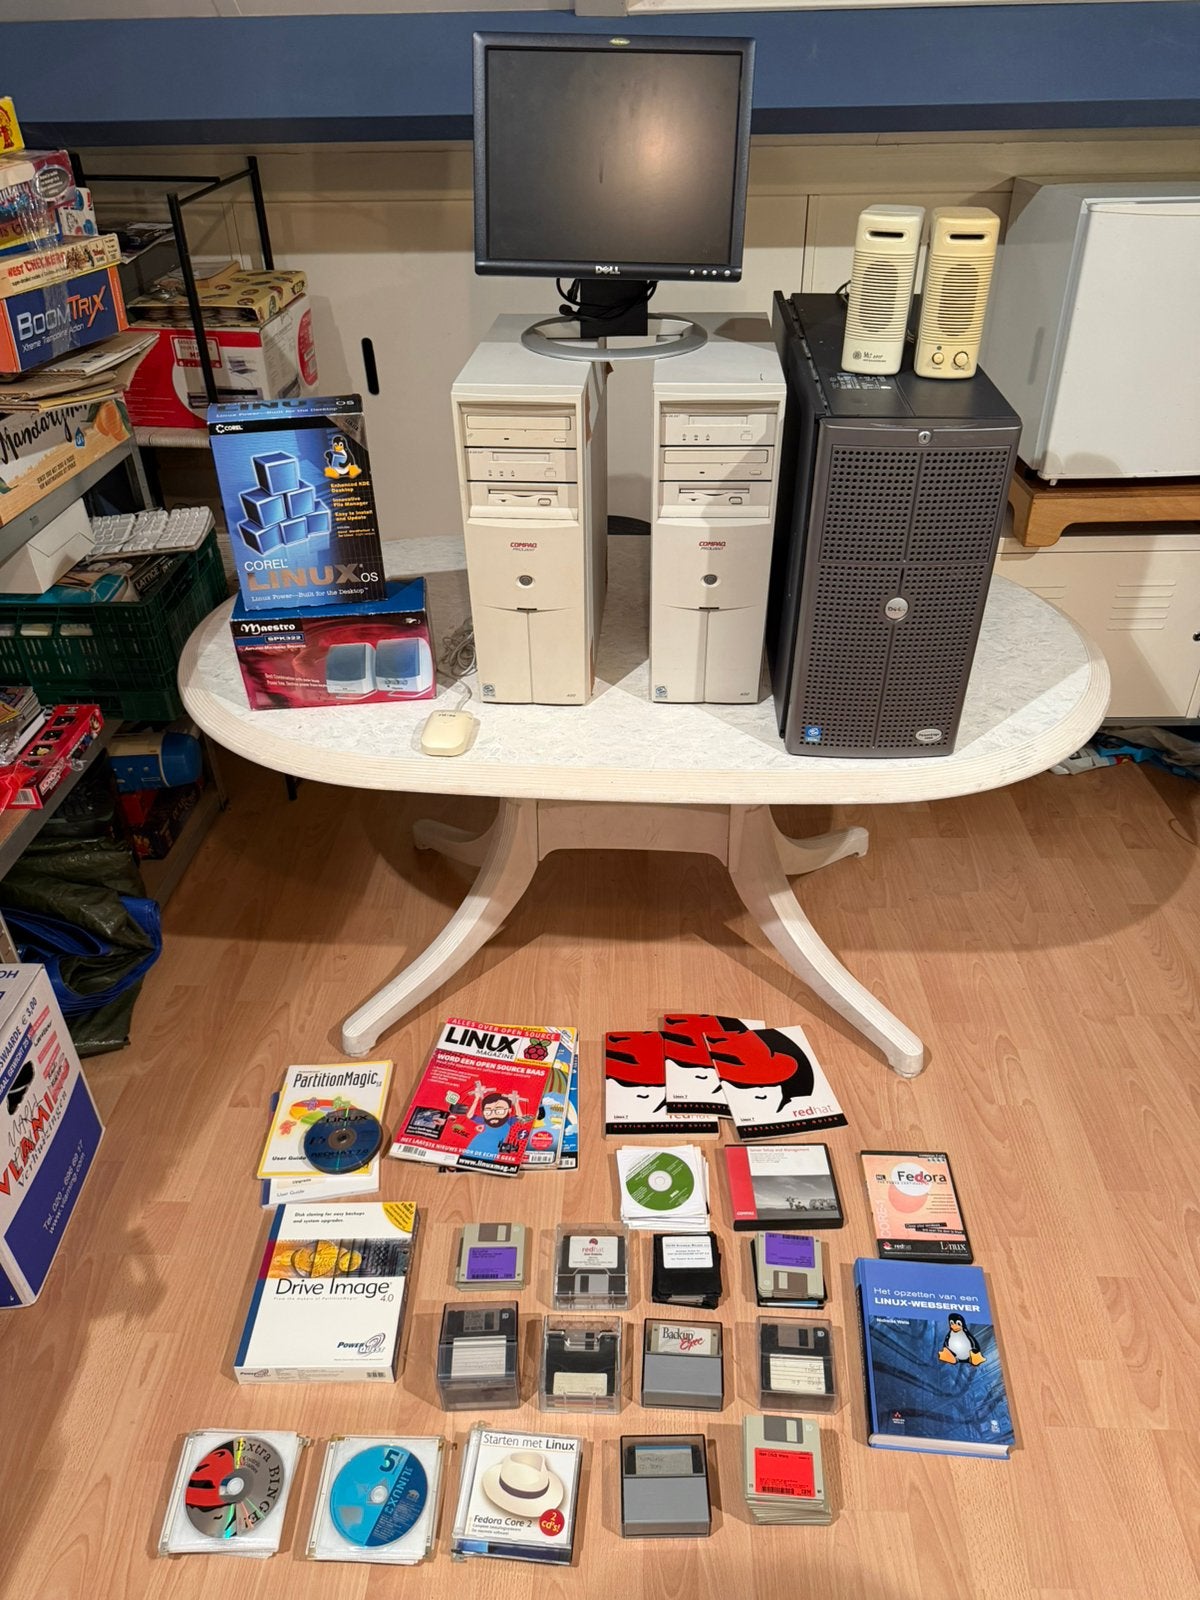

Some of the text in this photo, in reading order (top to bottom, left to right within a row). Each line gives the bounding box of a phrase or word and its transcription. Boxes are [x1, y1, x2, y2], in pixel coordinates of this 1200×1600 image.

[595, 265, 620, 275] DELL
[69, 323, 85, 334] Action
[510, 541, 538, 549] COMPAQ
[244, 559, 288, 572] COREL
[247, 563, 379, 592] LINUX OS
[240, 622, 296, 635] Maestro
[26, 996, 38, 1018] 3,00
[451, 1018, 556, 1040] ALLES OVER OPEN SOURCE
[444, 1026, 520, 1055] LINUX
[475, 1049, 514, 1060] MAGAZINE
[437, 1053, 459, 1063] WORD
[460, 1057, 475, 1066] EEN
[475, 1060, 496, 1070] OPEN
[496, 1064, 525, 1074] SOURCE
[525, 1069, 545, 1077] BAAS
[292, 1071, 379, 1088] PartitionMagic
[792, 1105, 834, 1118] redhat
[743, 1121, 807, 1132] INSTALLATION
[458, 1157, 518, 1173] www.linuxmag.nl
[897, 1171, 948, 1183] Fedora
[275, 1275, 391, 1299] Drive Image
[873, 1287, 891, 1296] Het
[893, 1291, 936, 1299] opzetten
[379, 1293, 395, 1303] 4.0
[874, 1297, 980, 1312] LINUX-WEBSERVER
[662, 1327, 694, 1341] Backup
[483, 1433, 576, 1451] Starten met Linux
[236, 1440, 272, 1463] Extra
[379, 1449, 400, 1472] 5
[474, 1514, 503, 1526] Fedora
[504, 1518, 525, 1527] Core
[551, 1512, 557, 1522] 2
